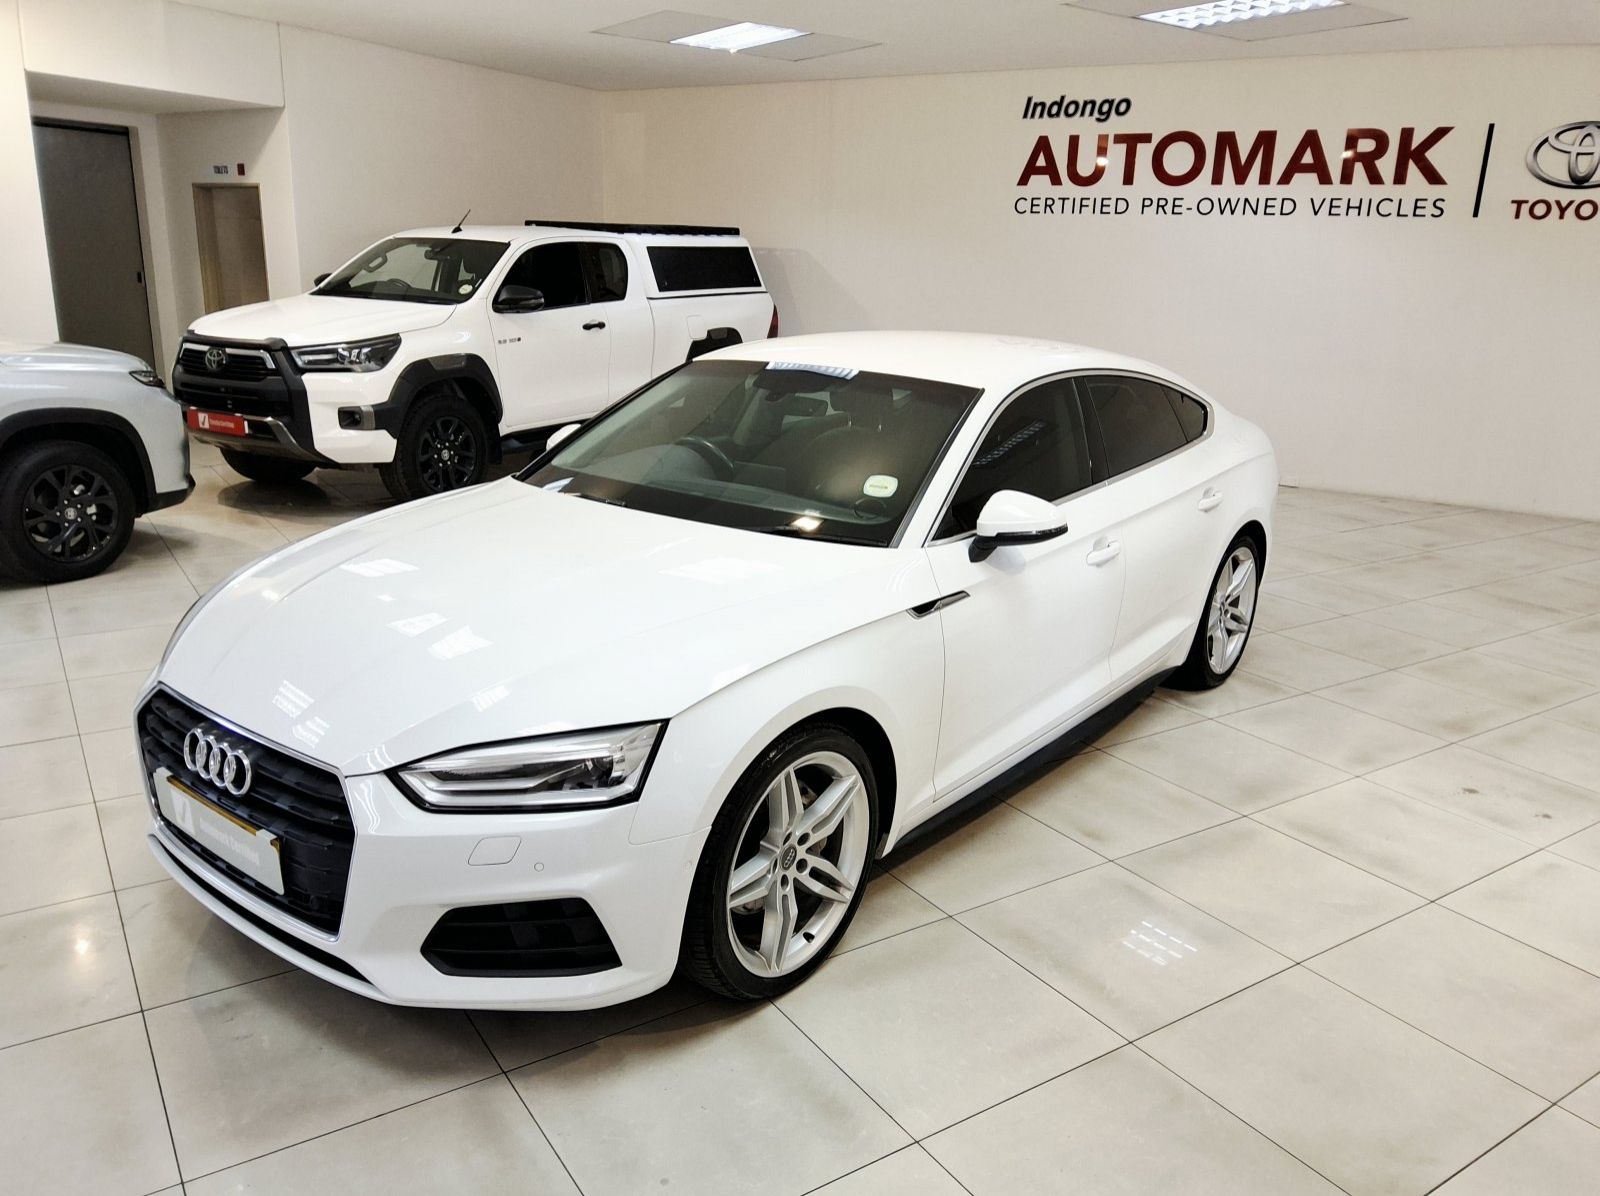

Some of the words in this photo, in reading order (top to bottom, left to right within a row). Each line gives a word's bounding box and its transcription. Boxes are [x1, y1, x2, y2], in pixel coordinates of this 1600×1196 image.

[1023, 95, 1131, 122] Indongo
[1017, 126, 1455, 187] AUTOMARK
[1014, 197, 1130, 215] CERTIFIED
[1141, 197, 1297, 216] PRE-OWNED
[1311, 197, 1446, 218] VEHICLES
